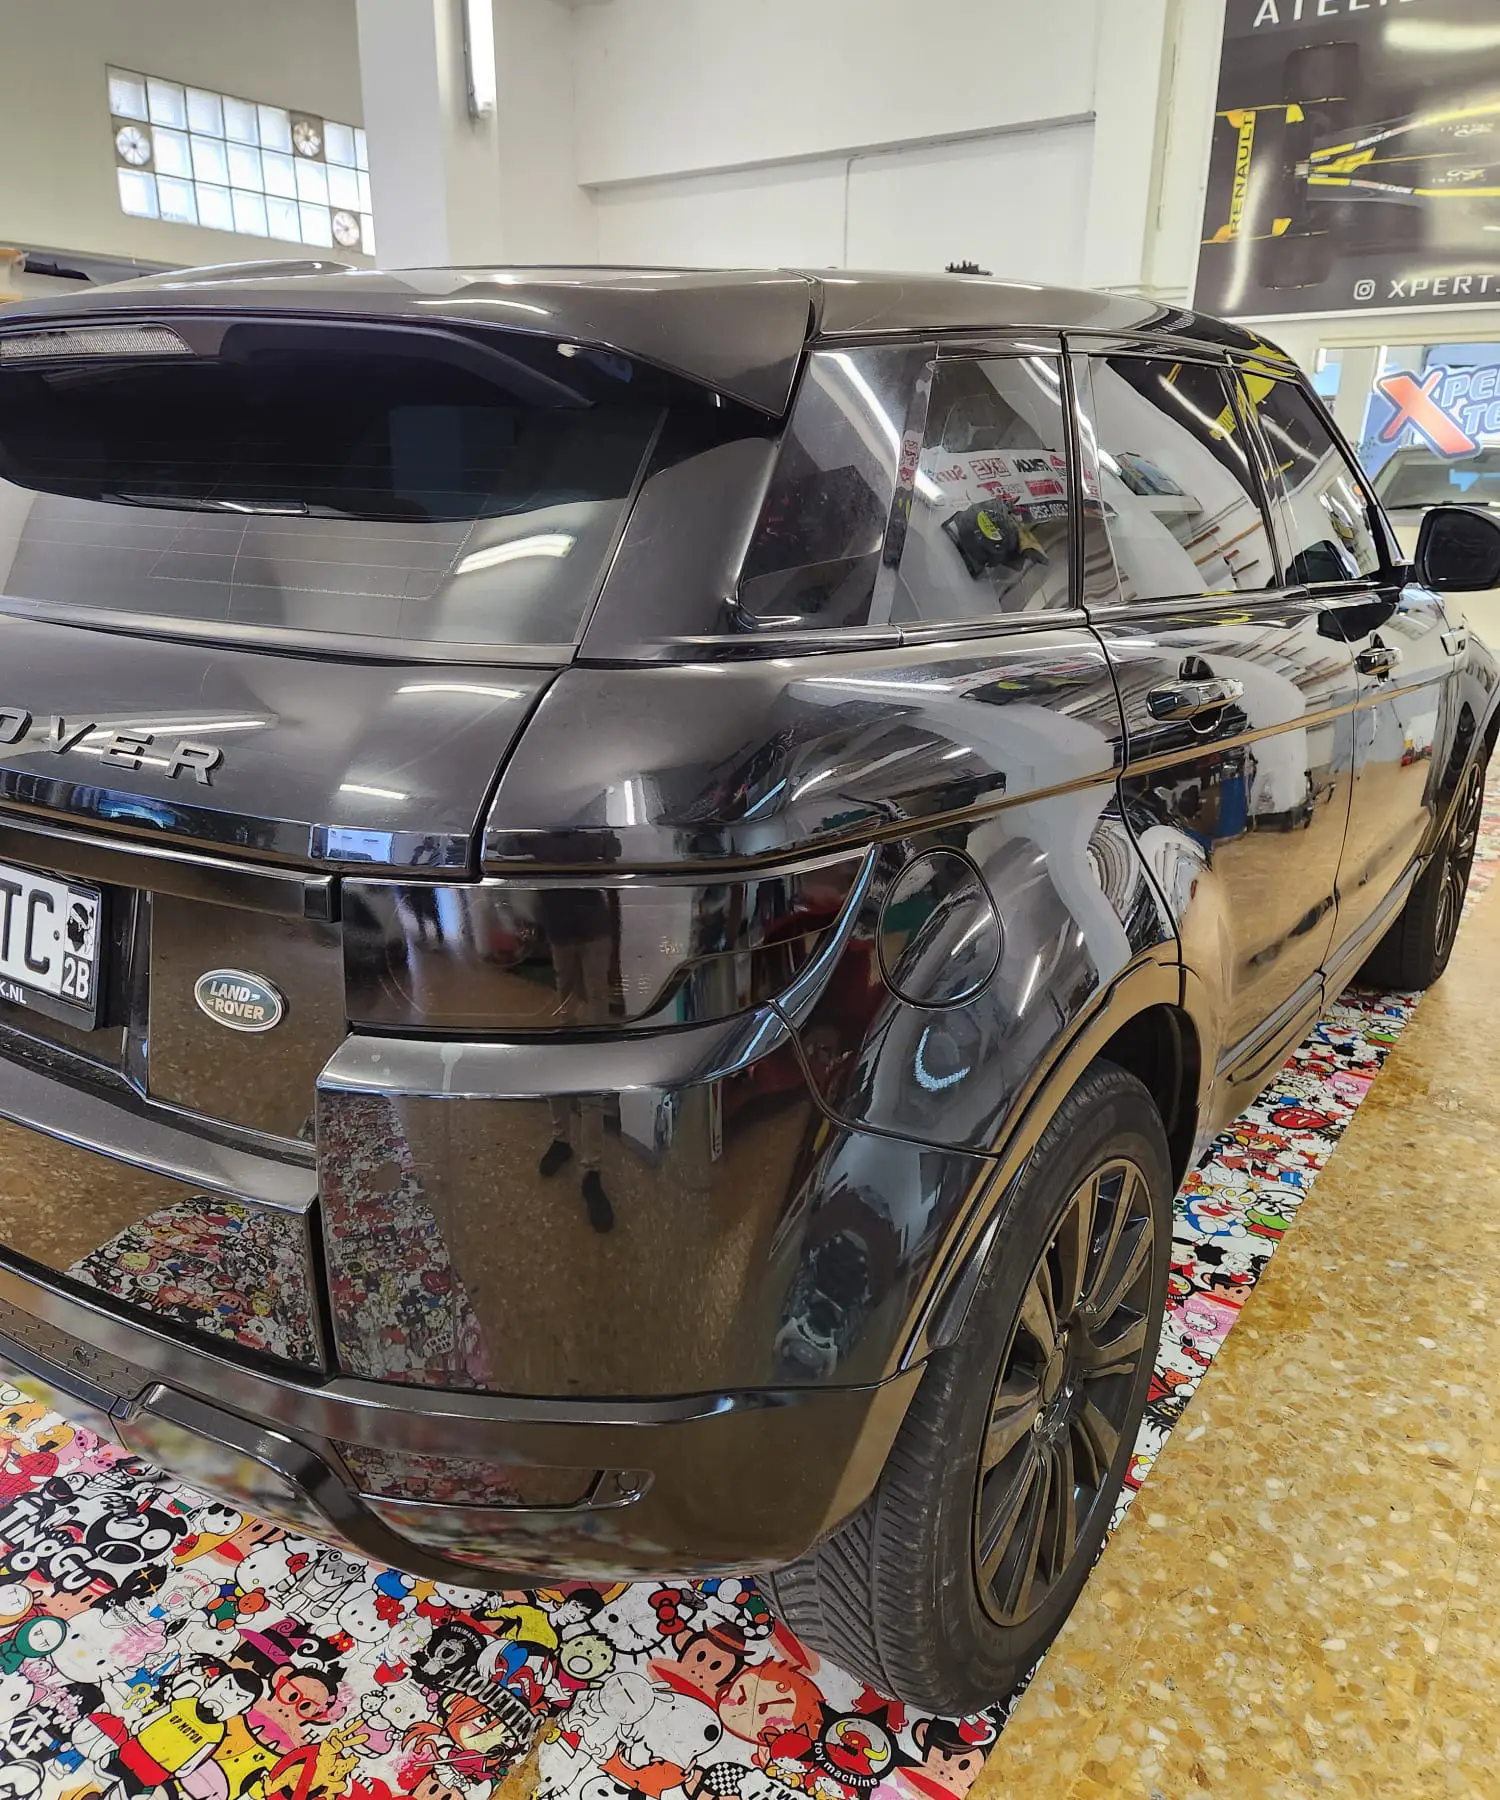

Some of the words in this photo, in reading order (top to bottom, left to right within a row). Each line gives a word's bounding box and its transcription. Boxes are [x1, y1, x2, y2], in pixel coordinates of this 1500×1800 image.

[1387, 274, 1500, 299] XPERT
[61, 957, 90, 1000] 2B
[210, 981, 250, 1002] LAND
[215, 998, 264, 1020] ROVER
[177, 1722, 203, 1744] MOTOR
[814, 1742, 826, 1761] toy
[824, 1762, 878, 1787] machine
